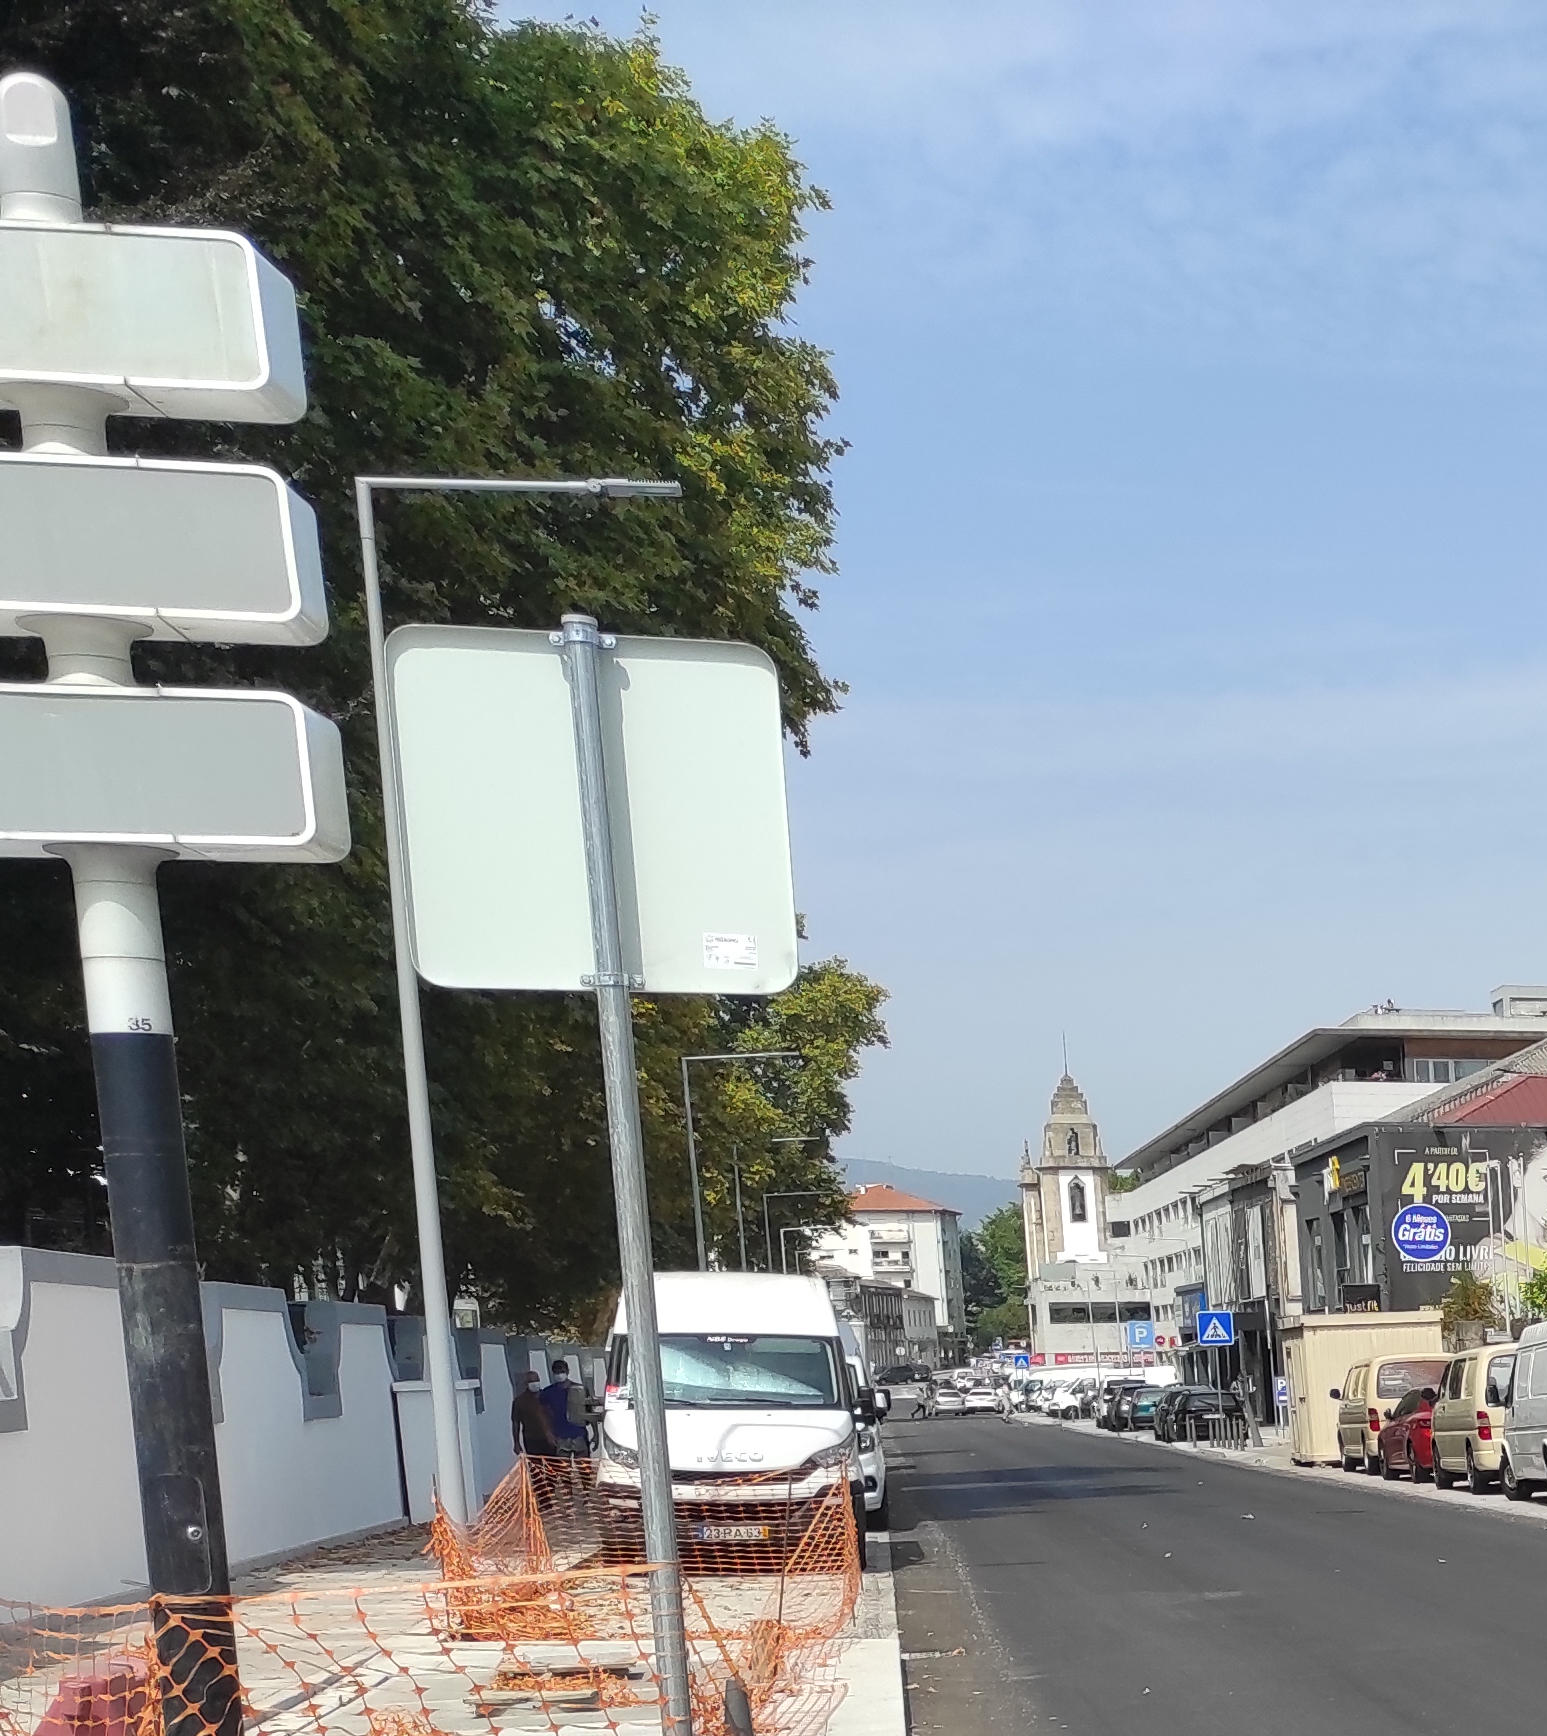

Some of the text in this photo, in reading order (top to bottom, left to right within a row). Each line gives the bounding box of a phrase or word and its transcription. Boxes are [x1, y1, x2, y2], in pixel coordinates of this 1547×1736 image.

[1432, 1193, 1485, 1204] POR SEMANA
[1398, 1223, 1445, 1241] Grátis
[1402, 1262, 1445, 1273] FELICIDADE
[1134, 1328, 1148, 1343] P
[696, 1452, 764, 1463] IVECO
